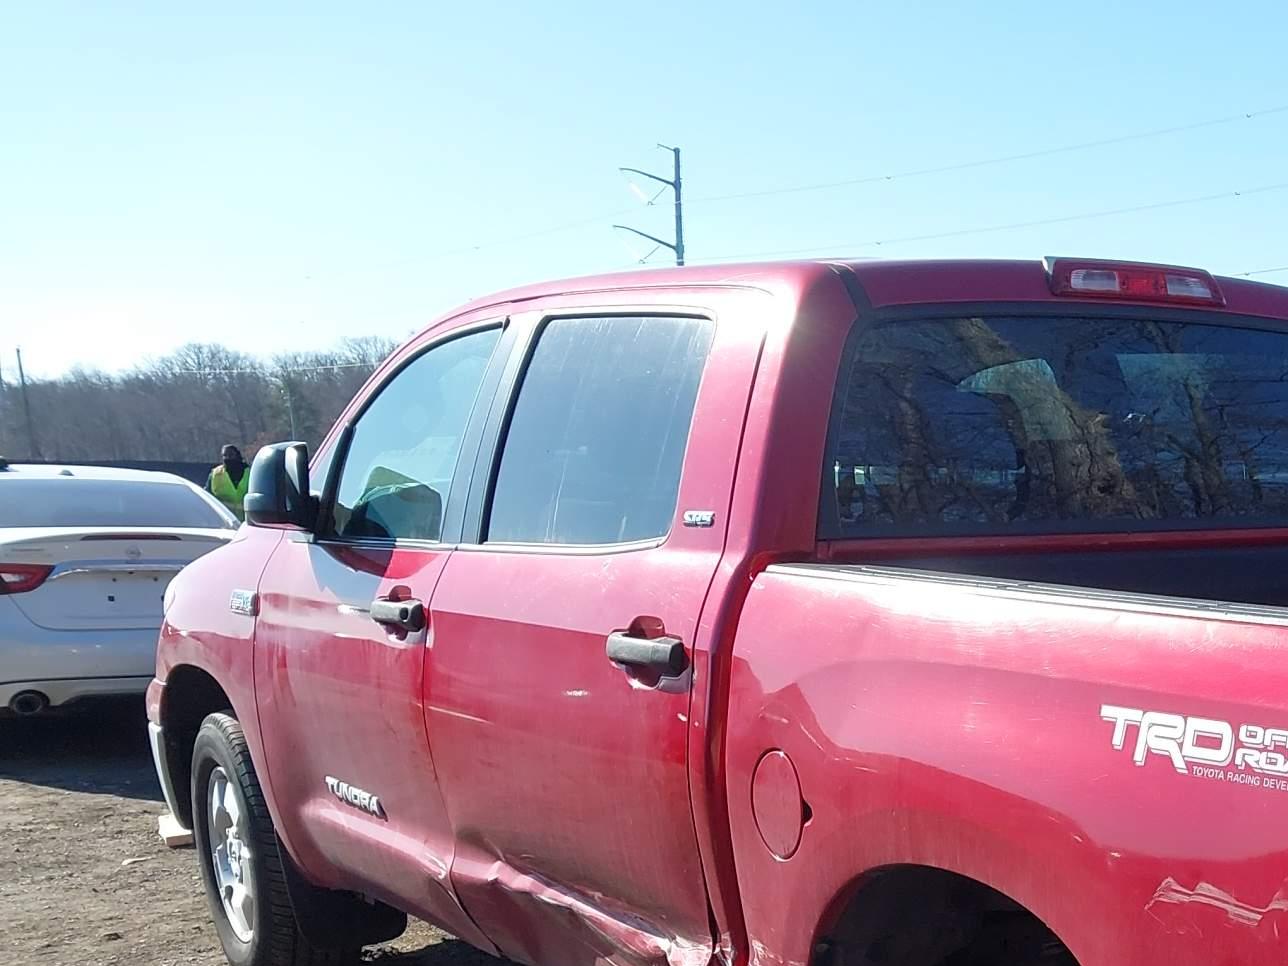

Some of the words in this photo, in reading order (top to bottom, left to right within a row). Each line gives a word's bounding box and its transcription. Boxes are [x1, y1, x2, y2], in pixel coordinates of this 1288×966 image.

[1100, 704, 1234, 774] TRD
[325, 775, 385, 818] TUNDRA
[1191, 765, 1225, 781] TOYOTA
[1227, 771, 1261, 787] RACING
